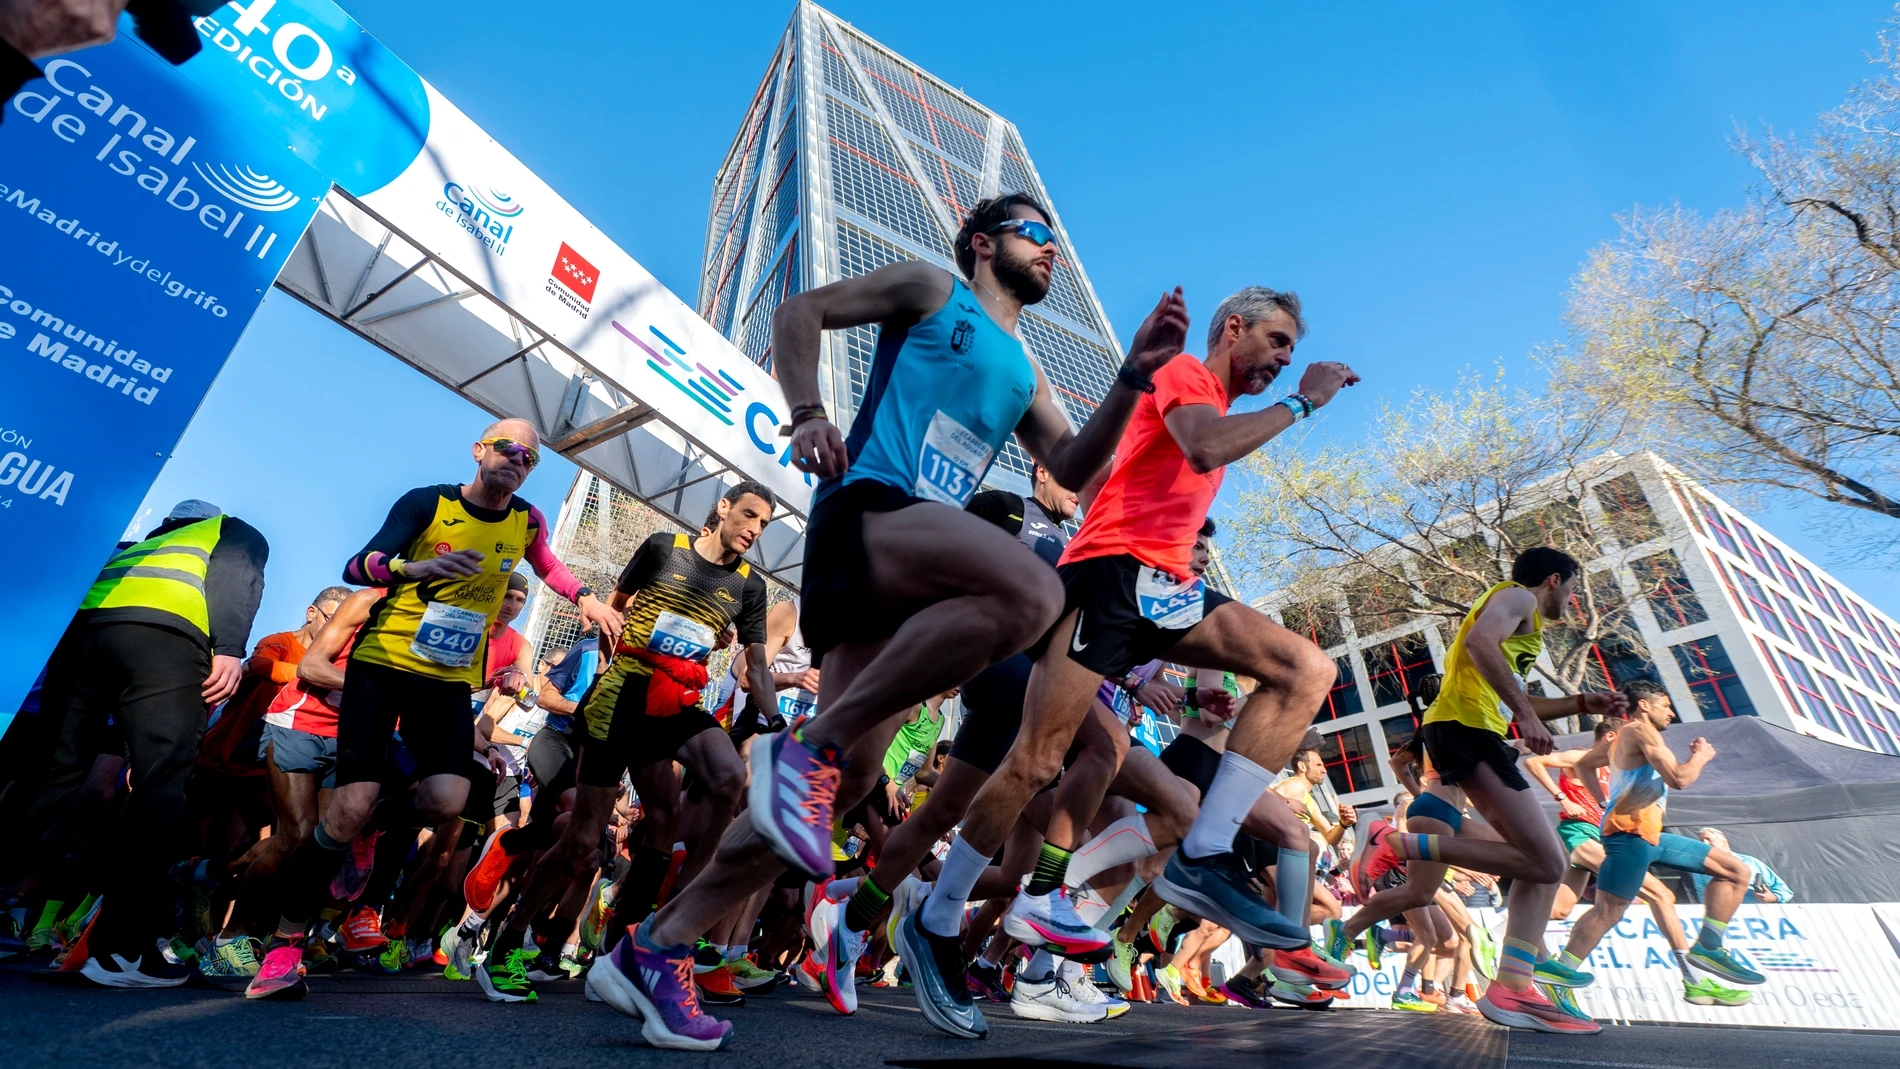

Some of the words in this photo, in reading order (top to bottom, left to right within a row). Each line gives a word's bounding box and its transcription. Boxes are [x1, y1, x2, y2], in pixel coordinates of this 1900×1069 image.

[193, 16, 328, 121] EDICIÓN
[44, 58, 197, 166] Canal
[13, 91, 86, 144] de
[95, 133, 245, 239] Isabel
[244, 224, 278, 260] II
[435, 200, 454, 218] de
[455, 213, 496, 249] Isabel
[495, 243, 505, 256] II
[443, 181, 513, 244] Canal
[545, 285, 557, 297] de
[558, 294, 588, 320] Madrid
[548, 278, 590, 313] Comunidad
[0, 284, 173, 385] Comunidad
[26, 332, 160, 405] Madrid
[950, 432, 962, 444] DEL
[460, 583, 495, 595] CLÍNICA
[427, 627, 476, 652] 940
[659, 636, 701, 659] 867
[784, 698, 816, 719] 1614
[1784, 984, 1865, 1014] Ojeda
